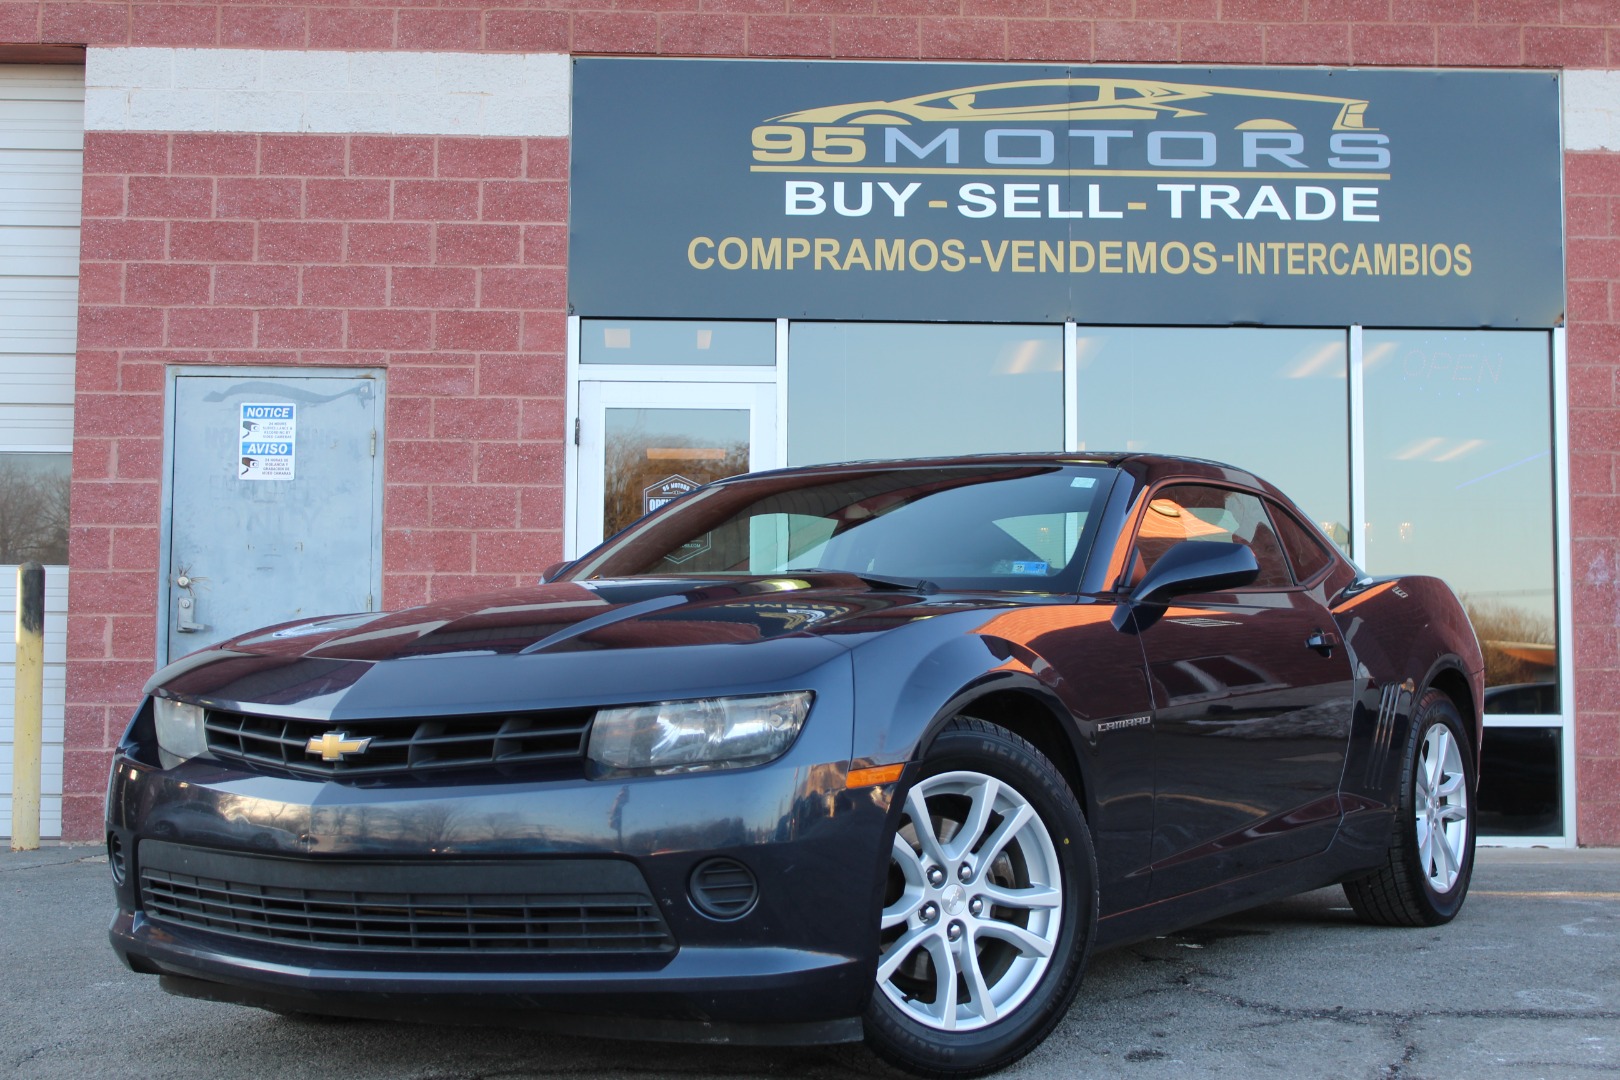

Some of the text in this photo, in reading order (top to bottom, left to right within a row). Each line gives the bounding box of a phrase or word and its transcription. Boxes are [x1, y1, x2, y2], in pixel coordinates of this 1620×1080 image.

[1402, 348, 1504, 384] OPEN
[246, 407, 290, 418] NOTICE
[246, 443, 288, 455] AVISO
[1097, 715, 1151, 732] CAMARO
